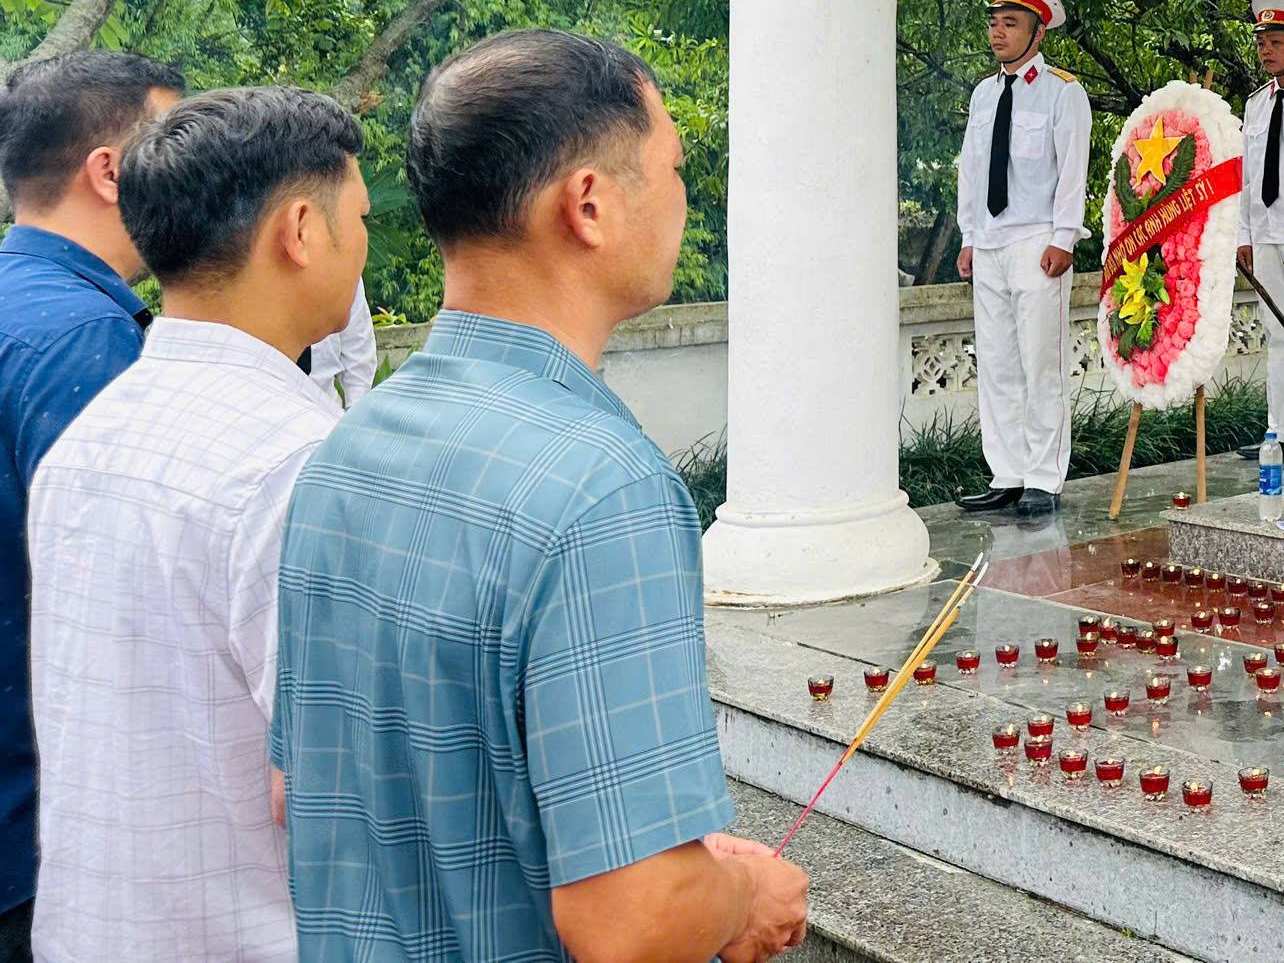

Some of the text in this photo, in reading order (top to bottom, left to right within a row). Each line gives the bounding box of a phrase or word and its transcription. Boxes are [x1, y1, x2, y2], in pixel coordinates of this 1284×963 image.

[1133, 225, 1149, 247] CÁC
[1145, 213, 1163, 239] ANH
[1159, 199, 1182, 228] HÙNG
[1178, 188, 1197, 212] LIỆT
